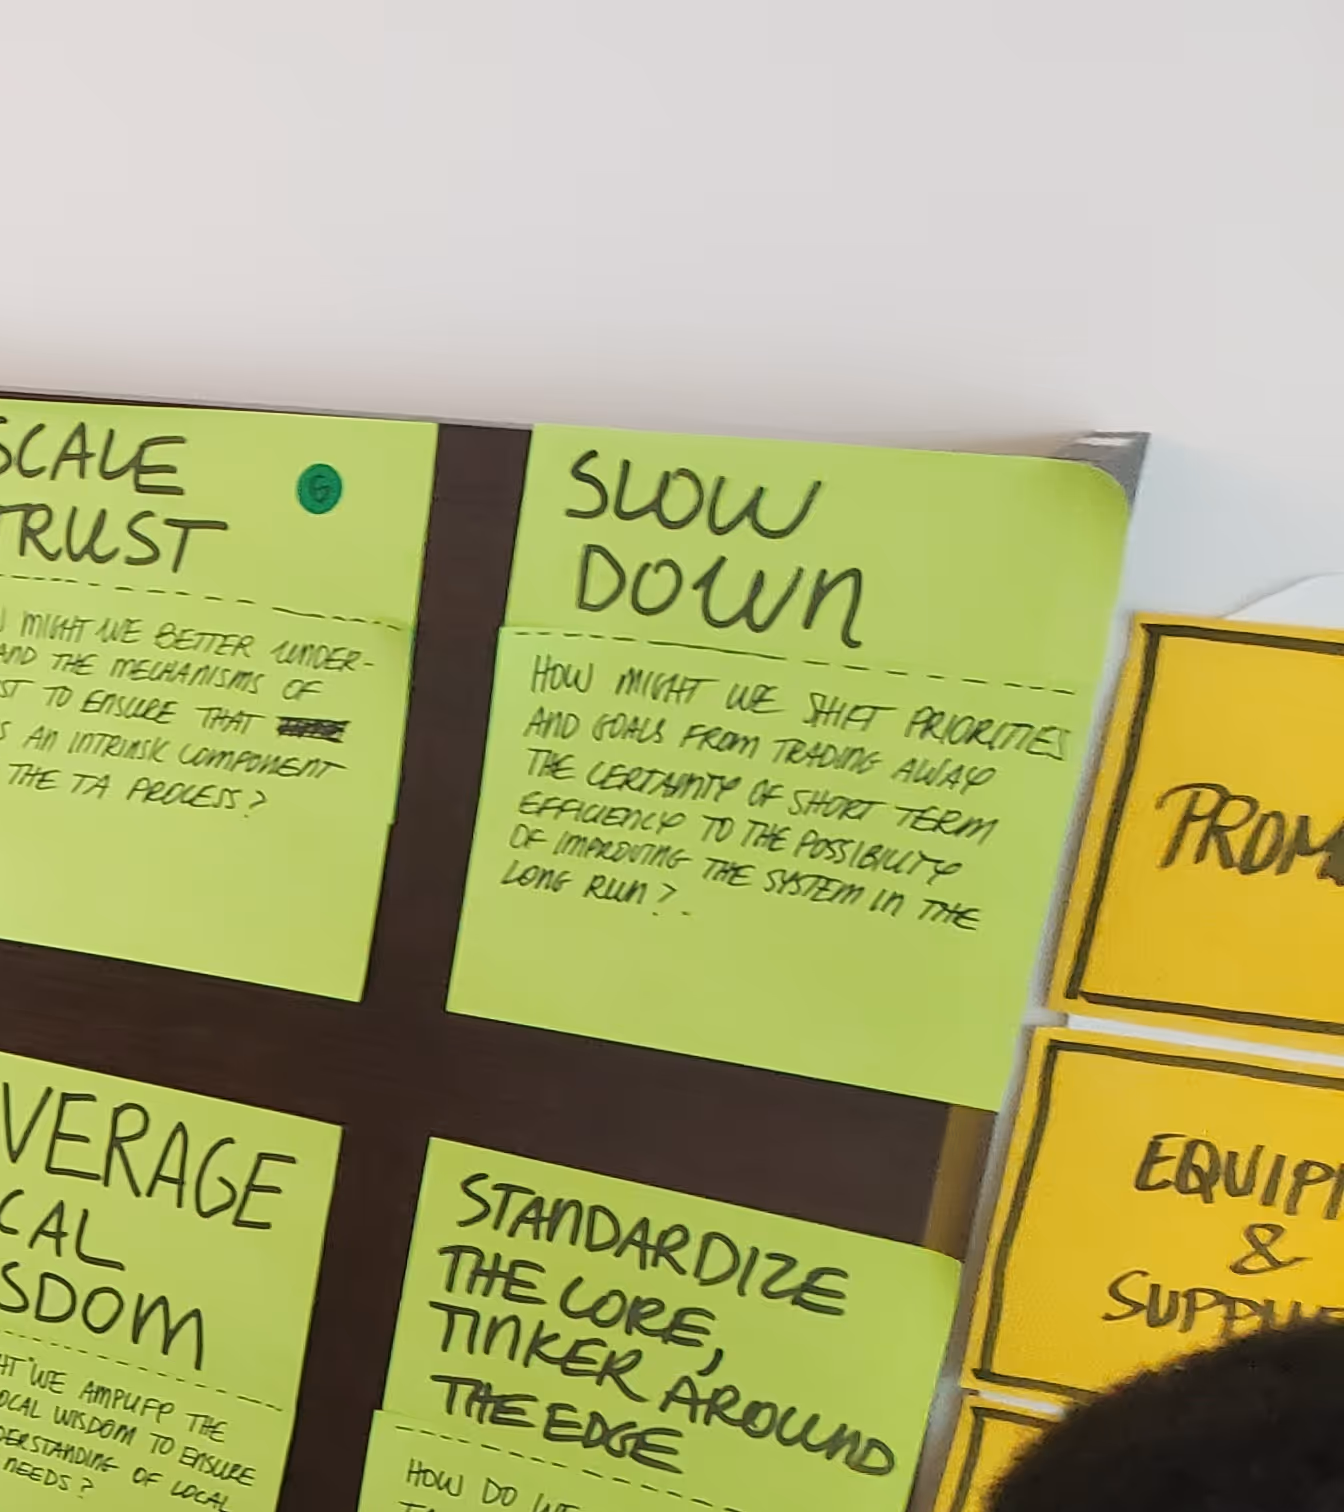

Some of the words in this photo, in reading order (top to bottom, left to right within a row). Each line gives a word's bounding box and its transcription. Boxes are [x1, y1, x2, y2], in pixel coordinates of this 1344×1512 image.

[565, 449, 822, 539] SLOW
[20, 611, 94, 642] MIGHT
[94, 618, 144, 644] WE
[154, 622, 255, 657] BETTER
[575, 544, 863, 649] DOWN
[42, 685, 73, 708] TO
[80, 689, 179, 724] ENSURE
[195, 707, 266, 735] THAT
[523, 705, 580, 740] AND
[592, 714, 667, 744] GOALS
[679, 724, 760, 759] FROM
[772, 738, 883, 775] TRADING
[891, 757, 997, 795] AWAY
[530, 653, 594, 694] HOW
[614, 667, 720, 705] MIGHT
[725, 683, 785, 714] WE
[808, 692, 899, 732] SHIFT
[904, 706, 1072, 761] PRIORITIES
[8, 763, 62, 790] THE
[72, 773, 111, 799] TA
[456, 1173, 849, 1316] STANDARDIZE
[1229, 1223, 1313, 1276] &
[437, 1245, 547, 1305] THE
[559, 1276, 724, 1377] CORE,
[428, 1301, 650, 1403] TINKER
[658, 1375, 896, 1477] AROUND
[430, 1375, 539, 1428] THE
[542, 1403, 684, 1476] EDGE
[53, 1406, 138, 1446] WISDOM
[150, 1432, 175, 1456] TO
[179, 1446, 257, 1487] ENSURE
[133, 1466, 163, 1488] OF
[406, 1458, 463, 1499] HOW
[481, 1477, 518, 1507] DO
